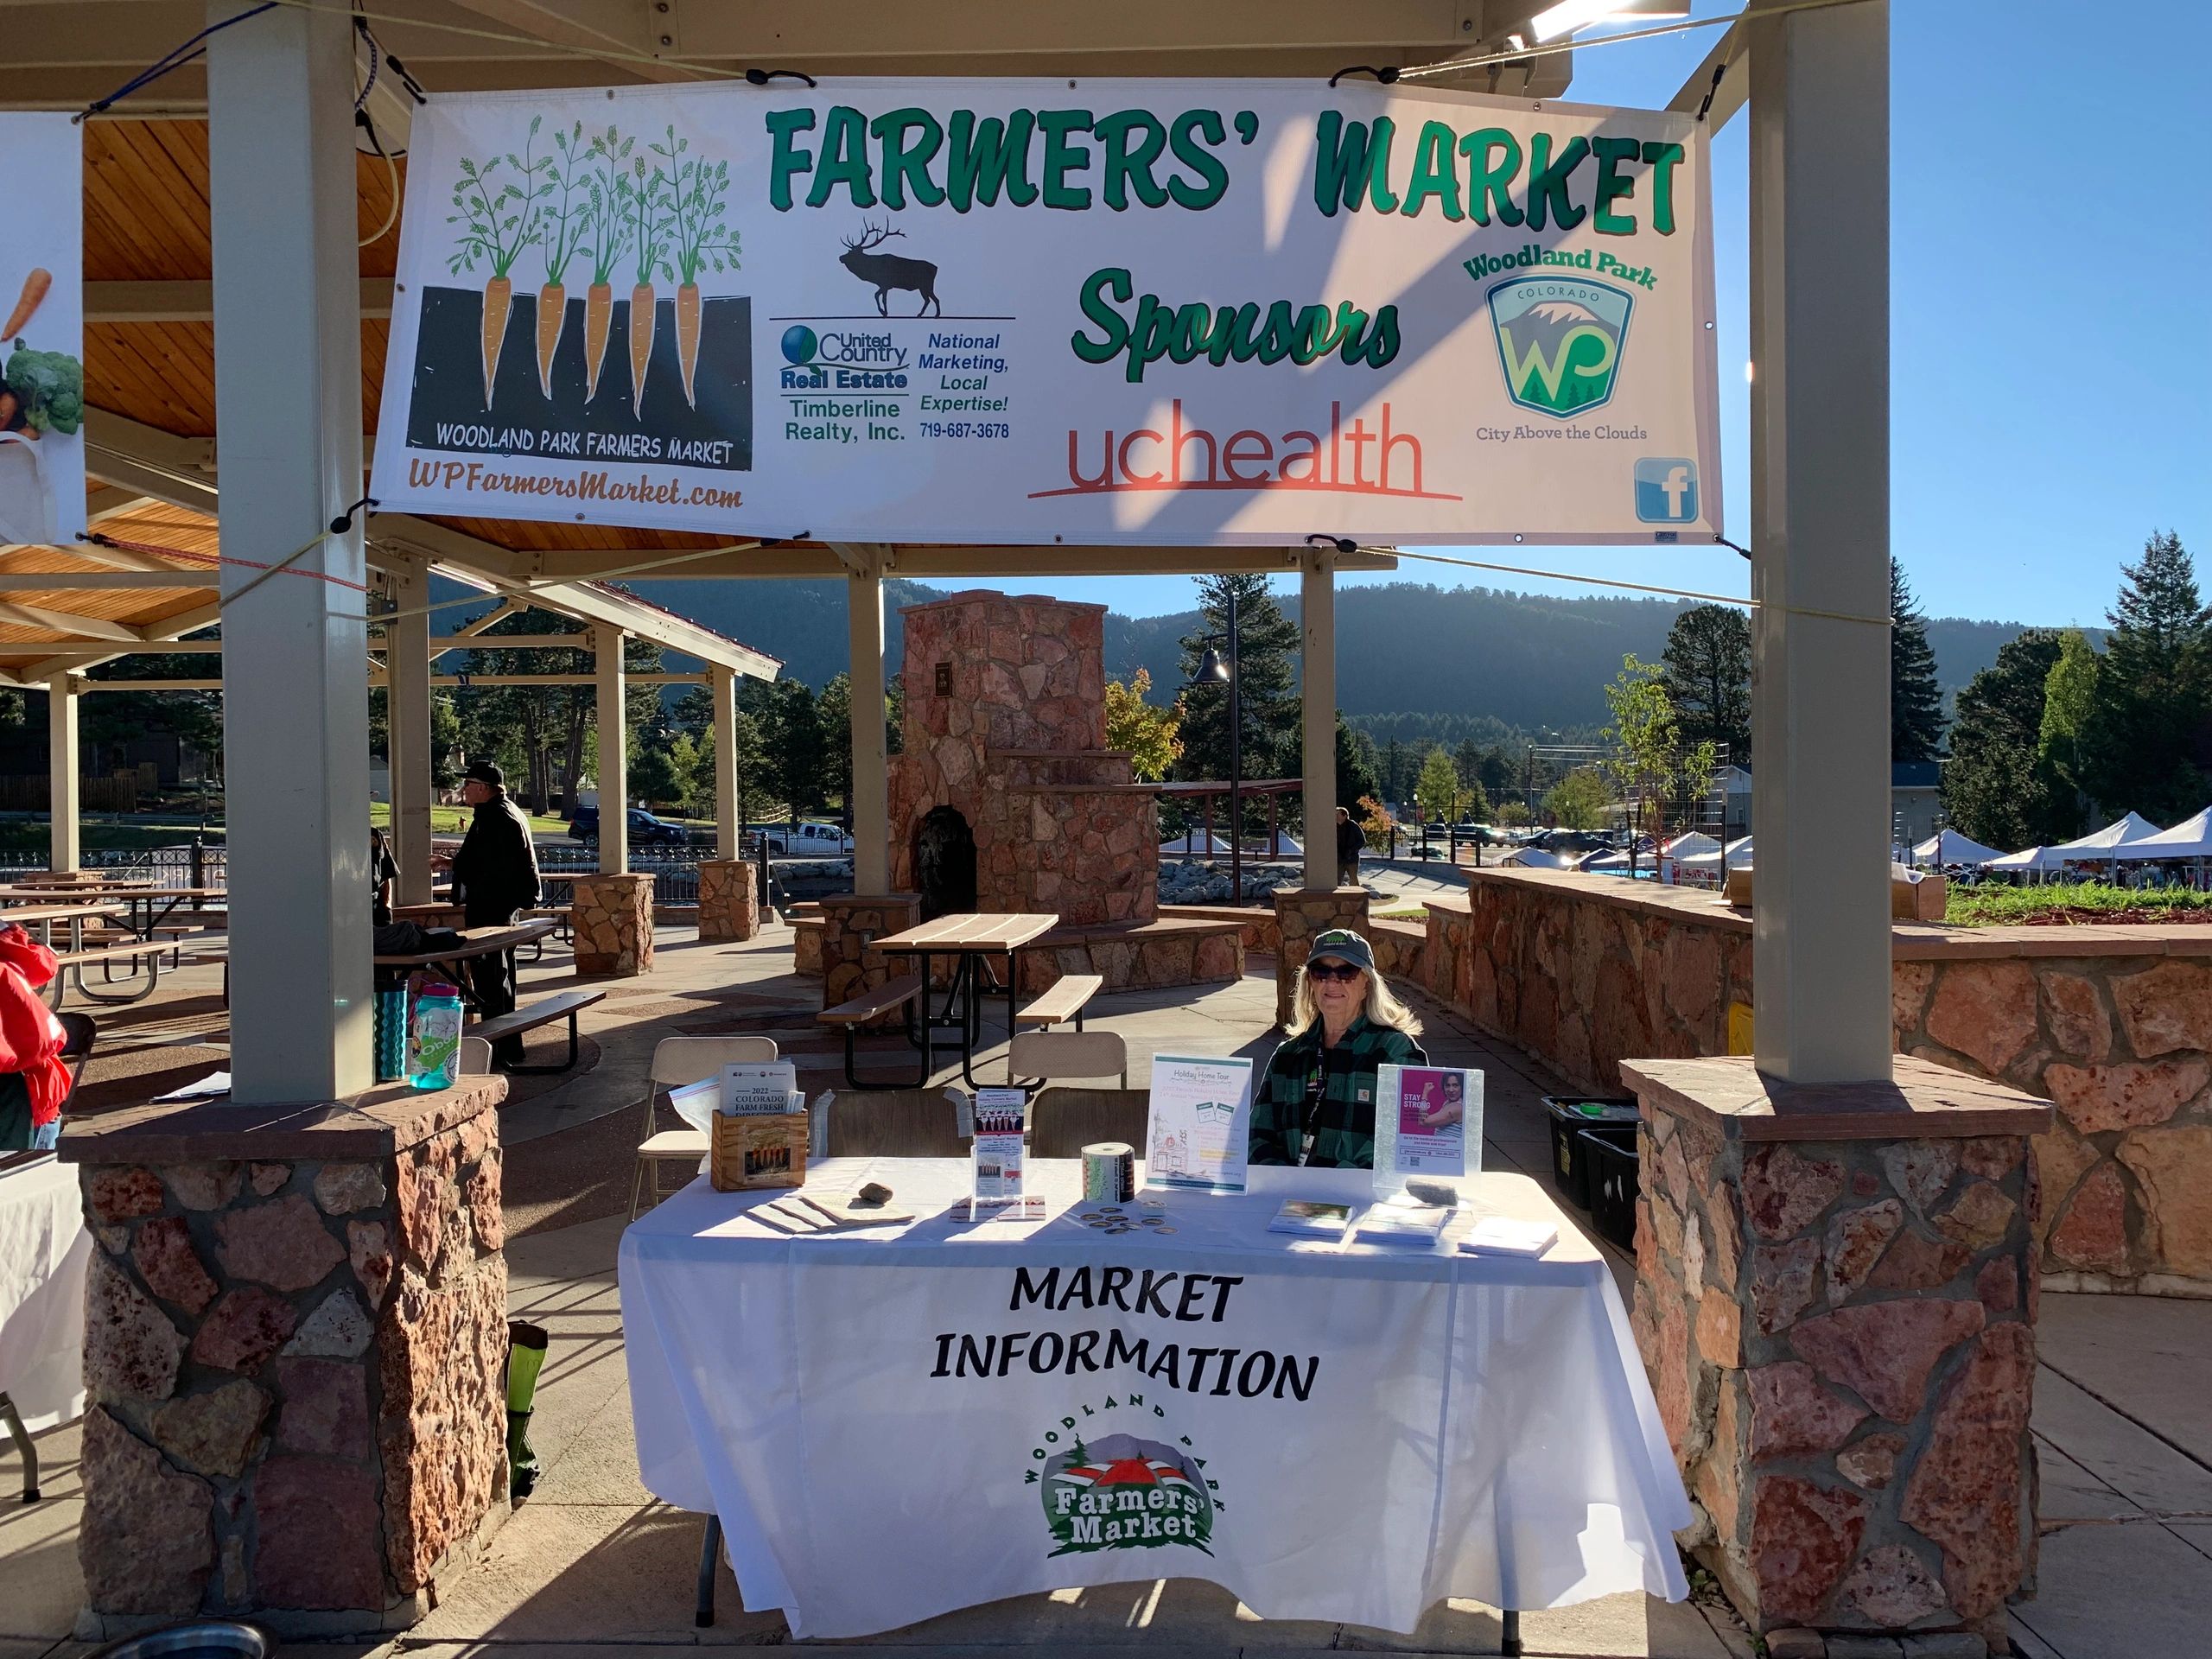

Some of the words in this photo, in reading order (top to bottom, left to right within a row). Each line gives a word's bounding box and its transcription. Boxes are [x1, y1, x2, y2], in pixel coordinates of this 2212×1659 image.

[766, 106, 1259, 213] FARMERS'
[1314, 110, 1685, 236] MARKET
[1463, 245, 1592, 281] Woodland
[1596, 251, 1658, 291] Park
[1518, 287, 1599, 302] COLORADO
[1071, 267, 1400, 383] Sponsors
[819, 333, 908, 366] Country
[840, 333, 892, 348] United
[928, 334, 1000, 348] National
[918, 354, 1008, 373] Marketing,
[781, 370, 828, 389] Real
[836, 370, 908, 389] Estate
[940, 375, 988, 390] Local
[790, 400, 900, 417] Timberline
[920, 396, 1008, 413] Expertise!
[785, 423, 858, 443] Realty,
[868, 423, 905, 440] Inc.
[920, 423, 1009, 438] 719-687-3678
[1477, 427, 1510, 442] City
[1513, 425, 1562, 439] Above
[1566, 425, 1591, 439] the
[1594, 426, 1647, 440] Clouds
[436, 423, 534, 451] WOODLAND
[540, 430, 580, 454] PARK
[587, 433, 661, 459] FARMERS
[667, 437, 734, 465] MARKET
[1069, 398, 1422, 493] uchealth
[409, 458, 743, 509] WPFarmersMarket.com
[1173, 1070, 1196, 1079] Holiday
[1009, 1266, 1243, 1323] MARKET
[930, 1329, 1319, 1402] INFORMATION
[1024, 1394, 1165, 1484] WOODLAND
[1179, 1435, 1225, 1512] PARK
[1055, 1487, 1205, 1515] Farmers'
[1071, 1512, 1197, 1543] Market
